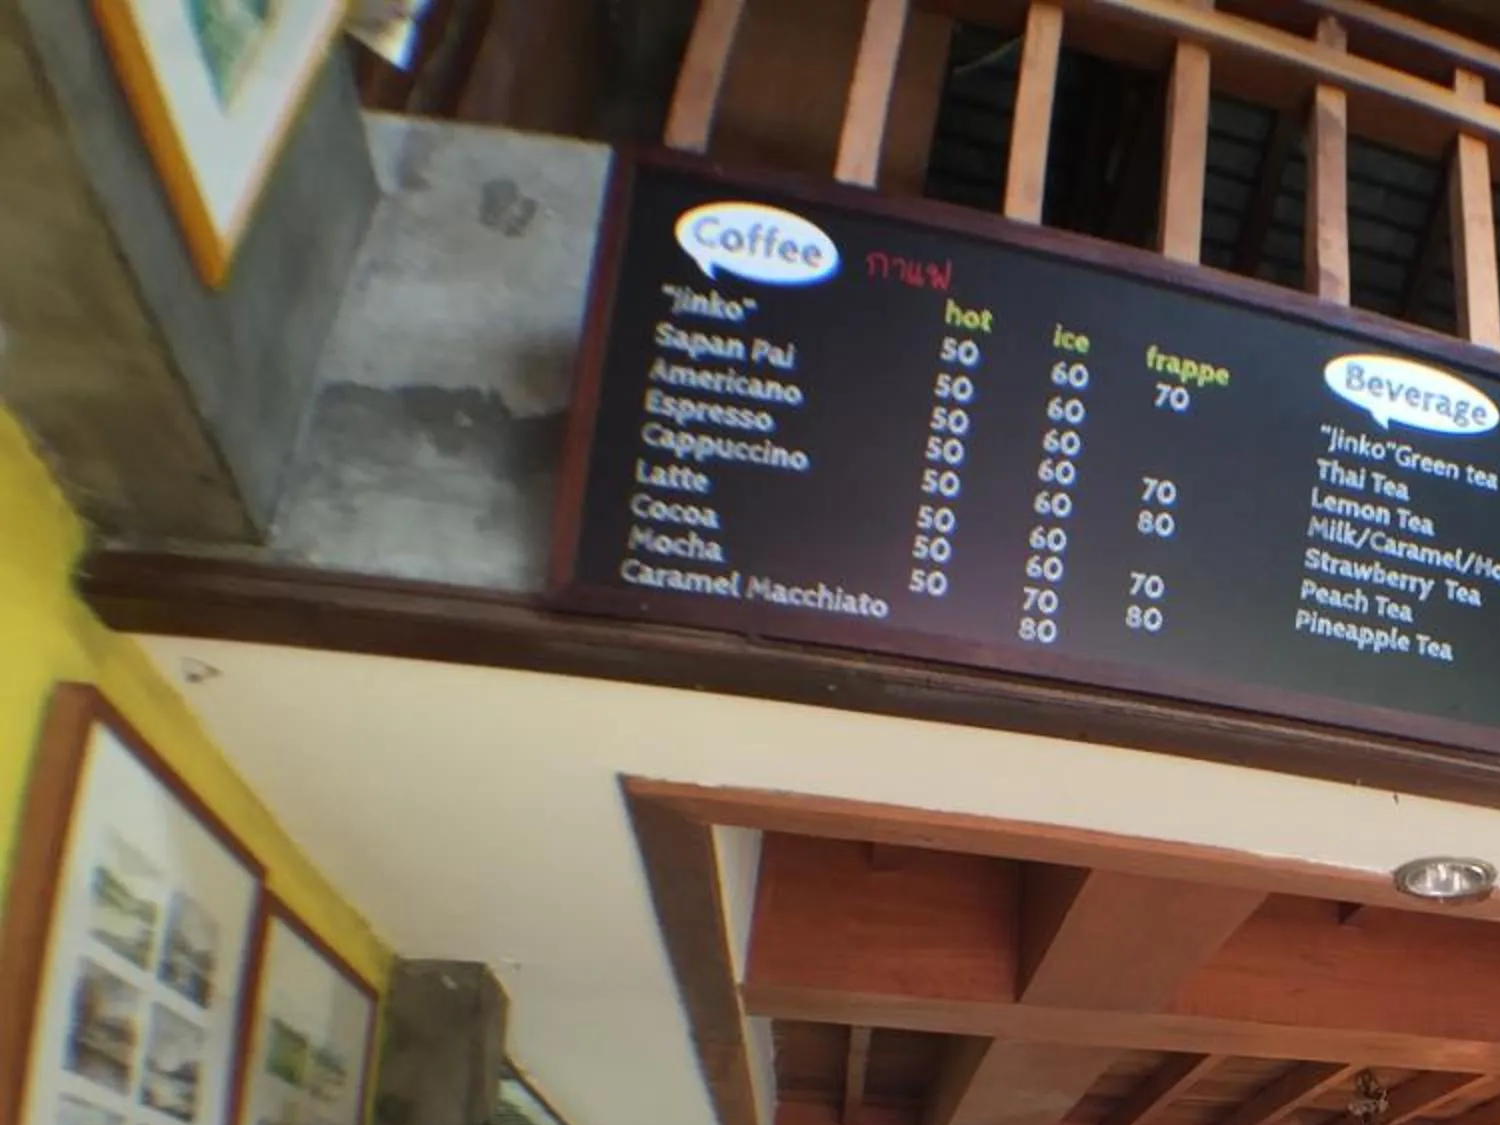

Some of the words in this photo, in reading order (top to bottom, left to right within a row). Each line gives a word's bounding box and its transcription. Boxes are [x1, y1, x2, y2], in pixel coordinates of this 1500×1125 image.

[692, 215, 824, 268] Coffee
[945, 298, 993, 334] hot
[655, 321, 745, 360] Sapan
[751, 338, 796, 369] Pai
[940, 335, 980, 366] 50
[1053, 322, 1090, 354] ice
[649, 357, 804, 406] Americano
[1051, 361, 1089, 390] 60
[1146, 345, 1229, 388] frappe
[934, 372, 974, 402] 50
[1154, 382, 1190, 412] 70
[1345, 361, 1487, 428] Beverage
[645, 387, 775, 433] Espresso
[929, 405, 969, 436] 50
[1047, 396, 1086, 424] 60
[641, 421, 810, 471] Cappuccino
[925, 435, 965, 465] 50
[1043, 428, 1081, 456] 60
[636, 458, 710, 493] Latte
[921, 468, 960, 497] 50
[1038, 458, 1076, 486] 60
[1316, 458, 1366, 490] Thai
[1372, 472, 1410, 502] Tea
[1466, 464, 1499, 491] tea
[1033, 490, 1072, 518] 60
[1142, 477, 1177, 505] 70
[630, 492, 721, 529] Cocoa
[916, 505, 956, 533] 50
[1138, 509, 1175, 537] 80
[1311, 486, 1390, 526] Lemon
[1397, 507, 1435, 536] Tea
[628, 524, 725, 563] Mocha
[912, 534, 951, 563] 50
[1029, 525, 1067, 552] 60
[908, 569, 948, 596] 50
[1026, 555, 1064, 582] 60
[1304, 547, 1436, 601] Strawberry
[1445, 578, 1482, 607] Tea
[620, 557, 741, 598] Caramel
[746, 574, 889, 619] Macchiato
[1023, 586, 1058, 614] 70
[1129, 571, 1165, 599] 70
[1301, 578, 1369, 614] Peach
[1376, 595, 1413, 623] Tea
[1019, 616, 1057, 643] 80
[1125, 604, 1163, 632] 80
[1295, 609, 1409, 652] Pineapple
[1416, 633, 1453, 662] Tea
